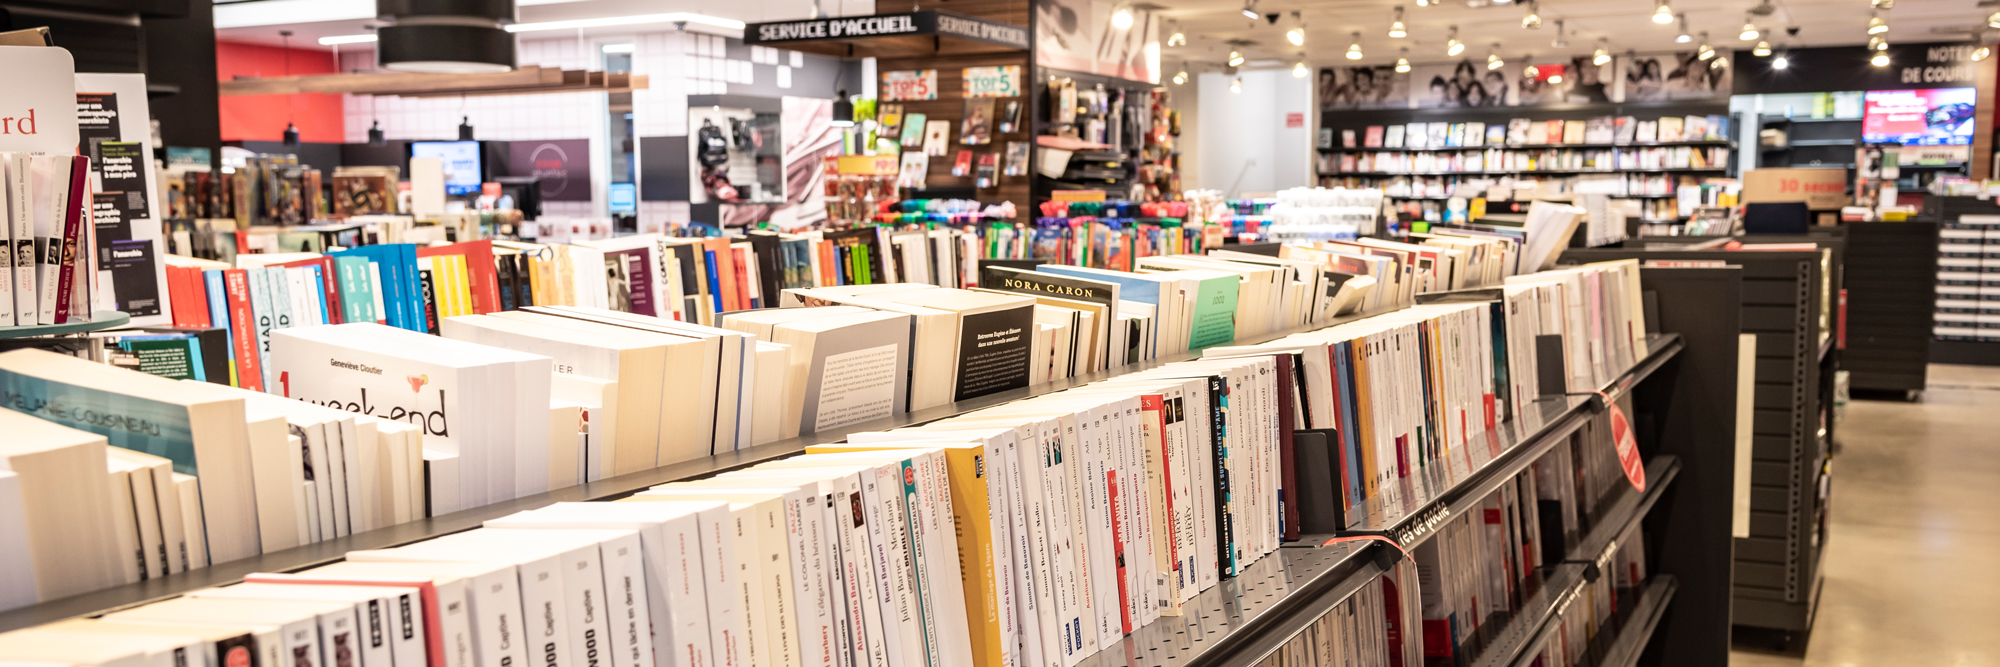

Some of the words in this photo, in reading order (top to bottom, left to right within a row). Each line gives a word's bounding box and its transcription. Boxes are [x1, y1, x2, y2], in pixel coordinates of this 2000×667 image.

[759, 21, 827, 41] SERVICE
[829, 16, 917, 37] D'ACCUEIL
[938, 15, 981, 37] SERVICE
[981, 22, 1028, 46] D'ACCUEIL
[892, 81, 914, 92] TOP
[917, 78, 928, 95] 5
[973, 77, 999, 90] TOP
[1000, 75, 1010, 92] 5
[1902, 67, 1921, 83] DE
[1923, 65, 1973, 83] COURS
[656, 239, 668, 284] COMPLOT
[63, 267, 71, 288] MICHAUX
[229, 273, 237, 295] JAMES
[237, 273, 246, 301] ROLLINS
[1005, 279, 1040, 291] NORA
[1047, 285, 1093, 298] CARON
[61, 289, 69, 305] HENRI
[421, 281, 431, 306] YOU
[238, 308, 250, 350] EXTINCTION
[260, 315, 271, 352] MAD
[245, 358, 253, 369] LA
[330, 358, 359, 371] Geneviève
[360, 363, 383, 375] Cloutier
[72, 406, 161, 437] COUSINEAU
[299, 388, 449, 438] k-end
[1104, 431, 1112, 460] Malavita
[1116, 429, 1125, 470] Romanesque
[1128, 425, 1136, 466] Romanesque
[1216, 432, 1225, 479] SUPPLÉMENT
[934, 458, 944, 502] BAUDELAIRE
[939, 455, 947, 475] PARIS
[1012, 461, 1020, 490] rompue
[1070, 444, 1079, 490] l'information
[919, 461, 929, 507] BAUDELAIRE
[927, 477, 932, 489] DU
[942, 476, 949, 486] DE
[1100, 460, 1109, 504] Benacquista
[1133, 473, 1142, 516] Benacquista
[1220, 481, 1226, 489] LE
[928, 490, 937, 517] FLEURS
[944, 488, 952, 513] SPLEEN
[1121, 477, 1129, 520] Benacquista
[1142, 490, 1151, 532] Benacquista
[795, 499, 803, 536] CHABERT
[872, 505, 881, 535] Ravage
[885, 499, 899, 550] Metroland
[910, 500, 919, 529] BATALHA
[948, 515, 953, 523] LE
[1018, 518, 1023, 527] La
[1114, 496, 1123, 543] MALAVITA
[1174, 510, 1182, 550] BERRY
[1185, 505, 1194, 546] BERRY
[1412, 514, 1426, 536] de
[1424, 500, 1451, 533] poche
[810, 520, 819, 556] hérisson
[841, 514, 851, 553] Emmaüs
[899, 525, 910, 567] BATAILLE
[914, 530, 922, 557] MARTHA
[799, 539, 808, 580] COLONEL
[815, 558, 821, 570] du
[877, 543, 888, 579] Barjavel
[984, 543, 992, 567] Figaro
[1020, 535, 1029, 569] Beauvoir
[1038, 536, 1046, 566] Beckett
[1080, 542, 1089, 576] Bellanger
[803, 583, 809, 592] LE
[848, 562, 857, 598] Baricco
[894, 559, 905, 592] Barnes
[919, 564, 927, 591] GUSMÃO
[986, 568, 993, 578] de
[1002, 564, 1010, 595] Beauvoir
[1041, 569, 1050, 598] Samuel
[582, 589, 594, 624] Captive
[623, 576, 633, 606] dernier
[775, 574, 784, 613] ILLUSIONS
[815, 572, 826, 617] L'élégance
[867, 589, 873, 600] La
[883, 581, 891, 603] René
[987, 579, 996, 610] mariage
[1025, 581, 1034, 610] Simone
[1083, 578, 1091, 609] Aurélien
[543, 601, 555, 637] Captive
[898, 594, 911, 622] Julian
[923, 592, 933, 626] D'EURÍDICE
[988, 611, 997, 622] Le
[499, 614, 511, 651] Captive
[627, 621, 637, 645] lâche
[840, 619, 848, 649] ÉPONYME
[852, 600, 864, 651] Alessandro
[927, 626, 936, 653] TALENTS
[723, 630, 732, 666] Atwood
[821, 625, 830, 662] Barbery
